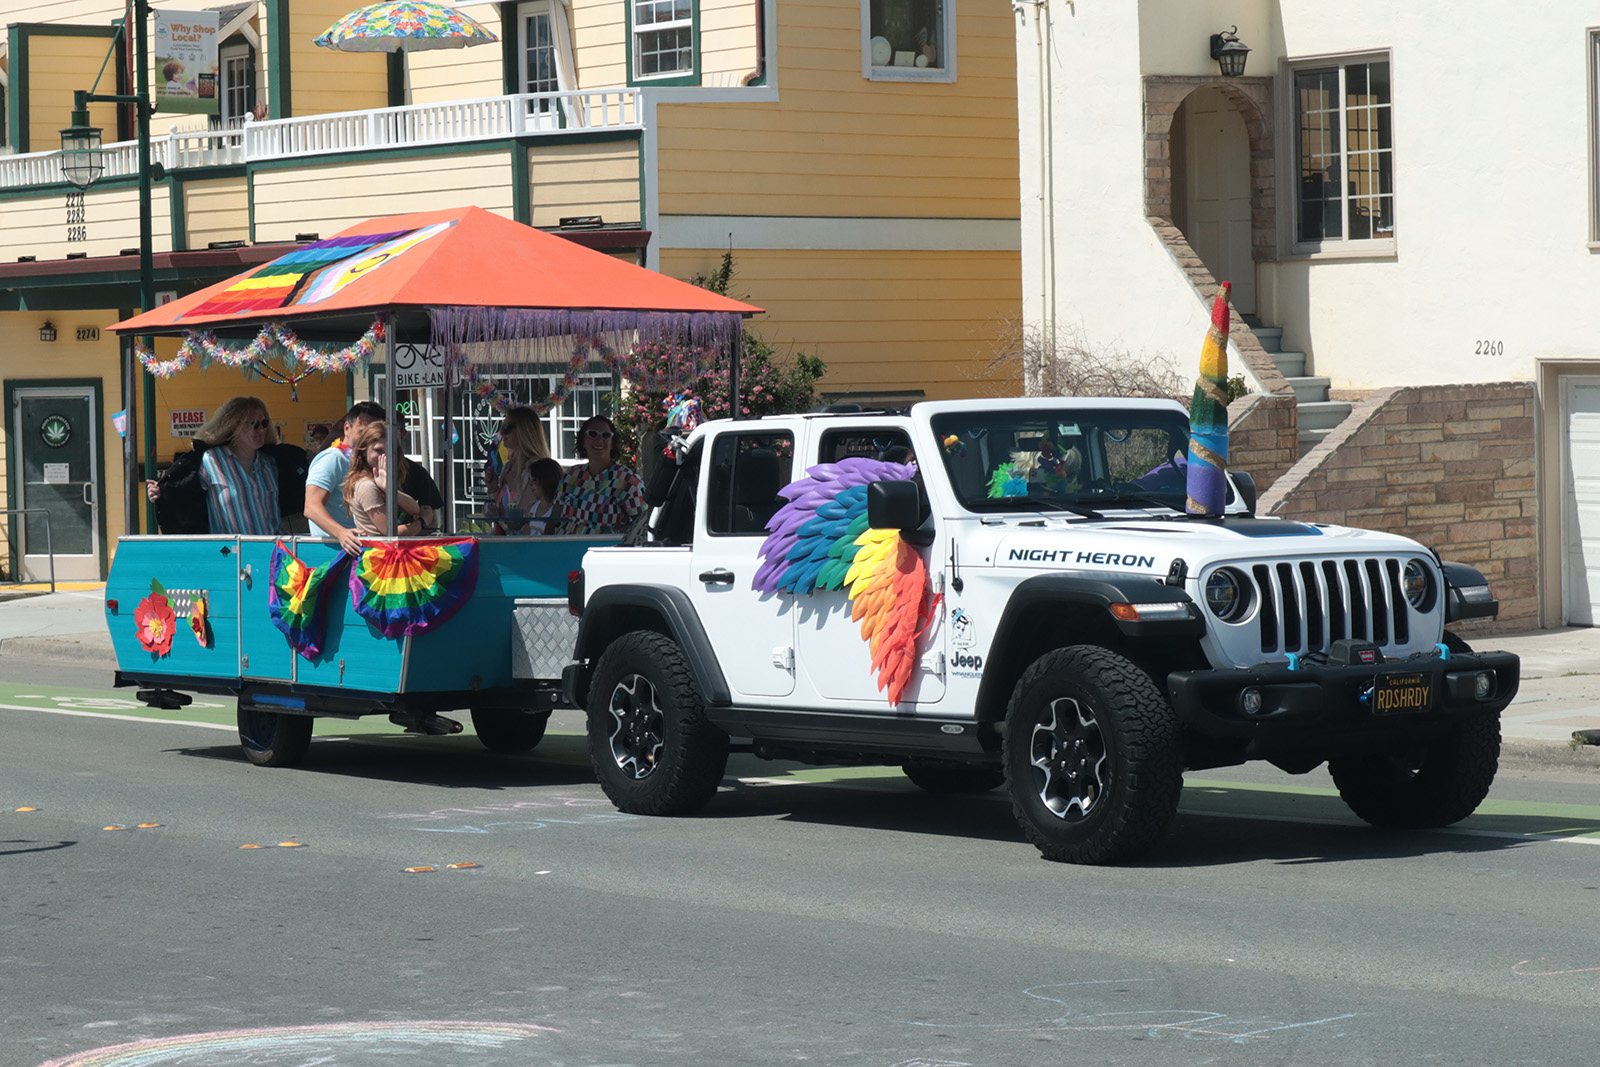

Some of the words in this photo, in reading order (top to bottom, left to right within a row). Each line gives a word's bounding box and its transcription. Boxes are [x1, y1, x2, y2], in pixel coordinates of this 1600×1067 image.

[171, 24, 191, 34] Why
[193, 25, 216, 36] Shop
[172, 33, 202, 42] Local?
[66, 192, 85, 208] 2278
[66, 208, 86, 224] 2282
[67, 225, 87, 242] 2286
[76, 329, 96, 340] 2274
[1475, 340, 1503, 356] 2260
[397, 373, 420, 386] BIKE
[424, 371, 444, 384] LAN
[172, 411, 204, 424] PLEASE
[1008, 549, 1074, 562] NIGHT
[1076, 551, 1156, 568] HERON
[950, 651, 983, 671] Jeep
[1389, 678, 1420, 686] CALIFORNIA
[1378, 687, 1430, 709] RDSHRDY
